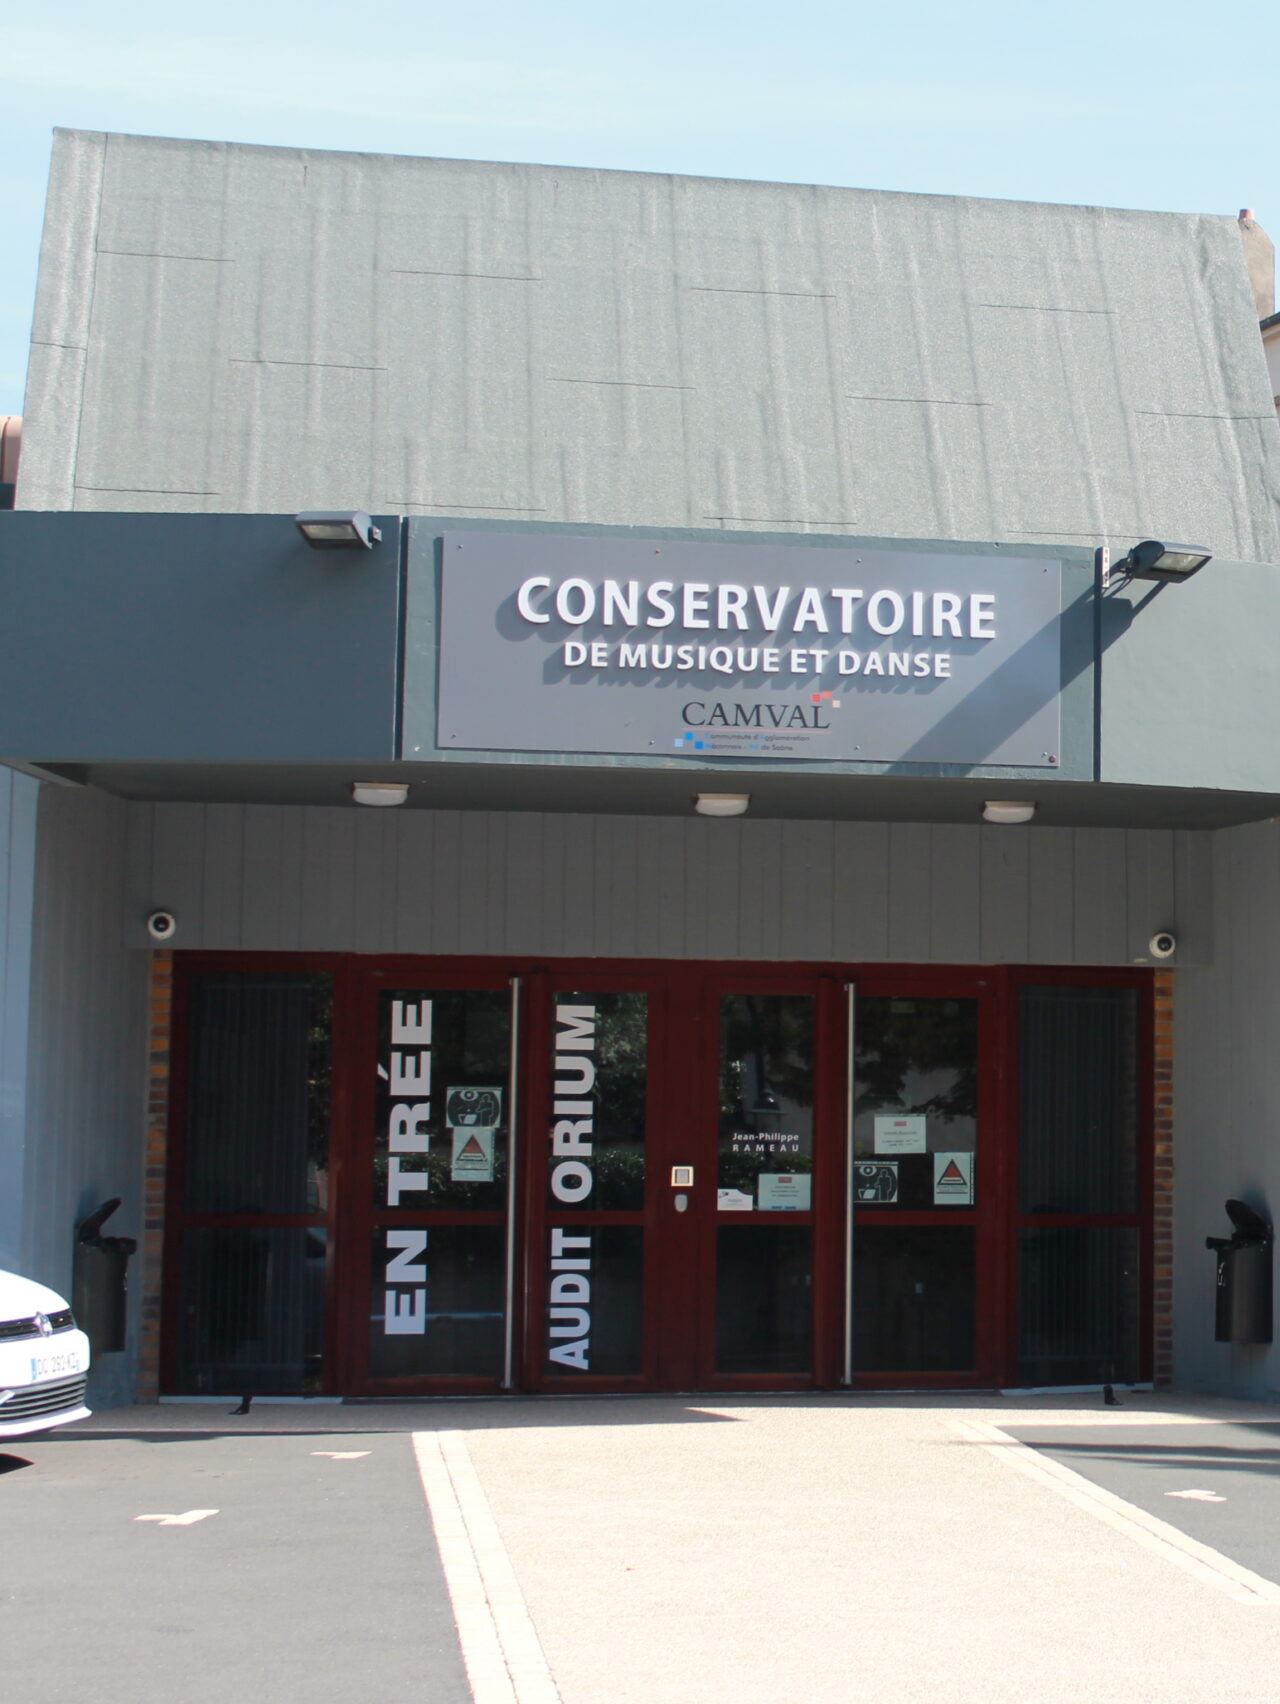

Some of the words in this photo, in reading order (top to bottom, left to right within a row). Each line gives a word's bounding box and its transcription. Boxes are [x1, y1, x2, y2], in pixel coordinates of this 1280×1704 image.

[516, 576, 996, 639] CONSERVATOIRE
[564, 641, 608, 668] DE
[618, 644, 781, 674] MUSIQUE
[790, 649, 829, 674] ET
[838, 651, 952, 679] DANSE
[682, 701, 831, 729] CAMVAL
[732, 1132, 800, 1142] Jean-Philippe
[732, 1144, 799, 1153] RAMEAU
